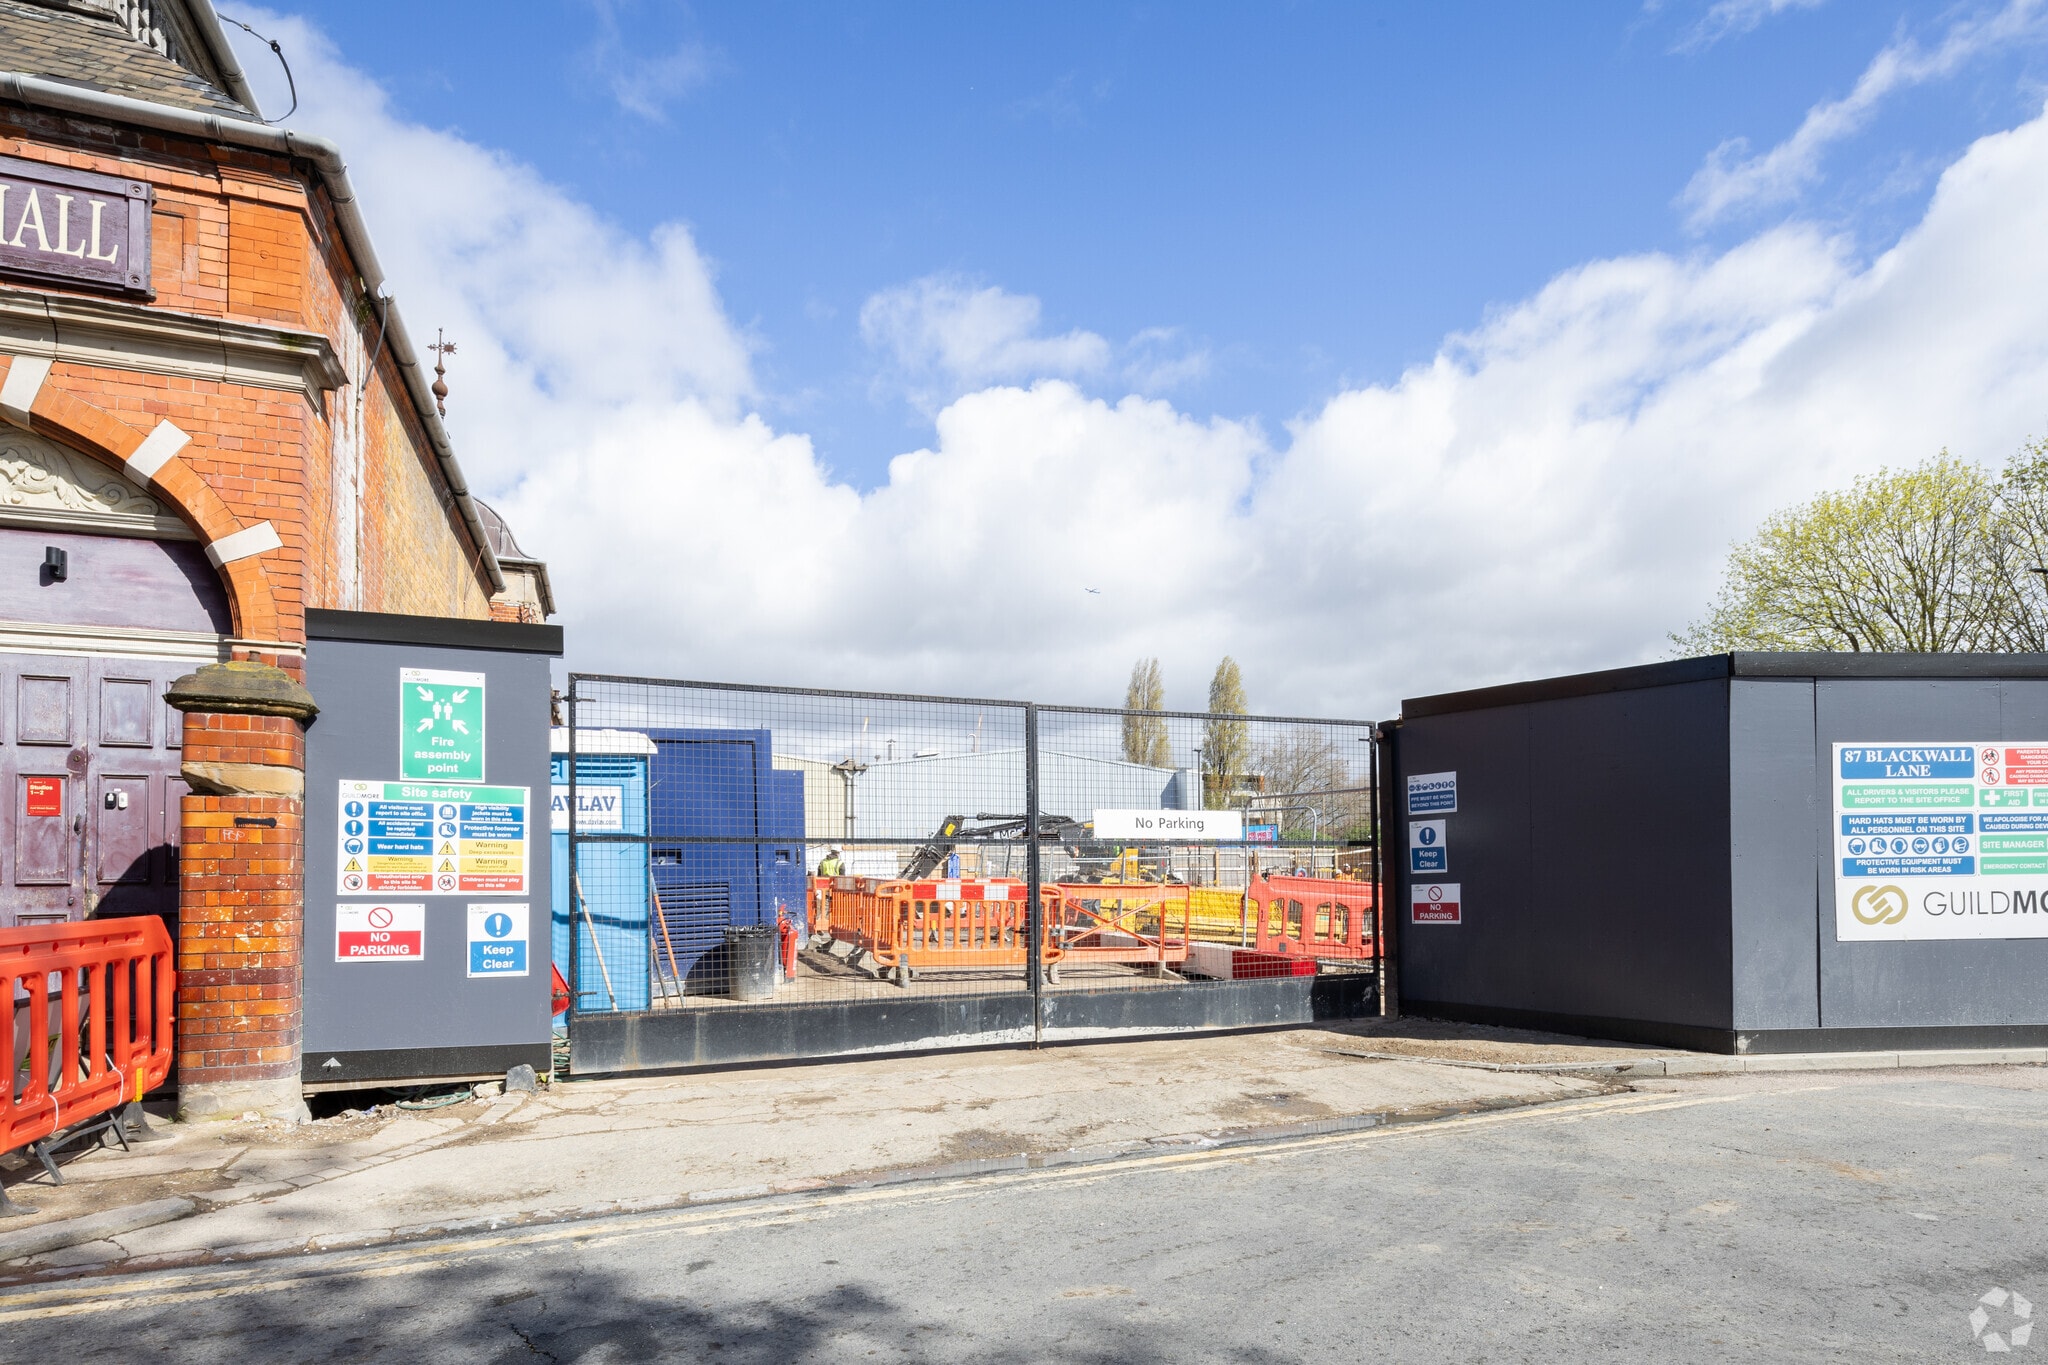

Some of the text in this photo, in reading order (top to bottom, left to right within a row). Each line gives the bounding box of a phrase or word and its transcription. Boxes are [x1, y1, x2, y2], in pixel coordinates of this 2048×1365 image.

[432, 736, 454, 746] Fire
[414, 751, 471, 762] assembly
[1844, 749, 1971, 762] 87 BLACKWALL
[427, 763, 459, 774] point
[1886, 764, 1931, 777] LANE
[402, 786, 472, 801] Site safety
[1135, 817, 1204, 832] No Parking
[370, 932, 390, 943] NO
[350, 944, 410, 955] PARKING
[483, 945, 514, 956] Keep
[482, 959, 514, 969] Clear
